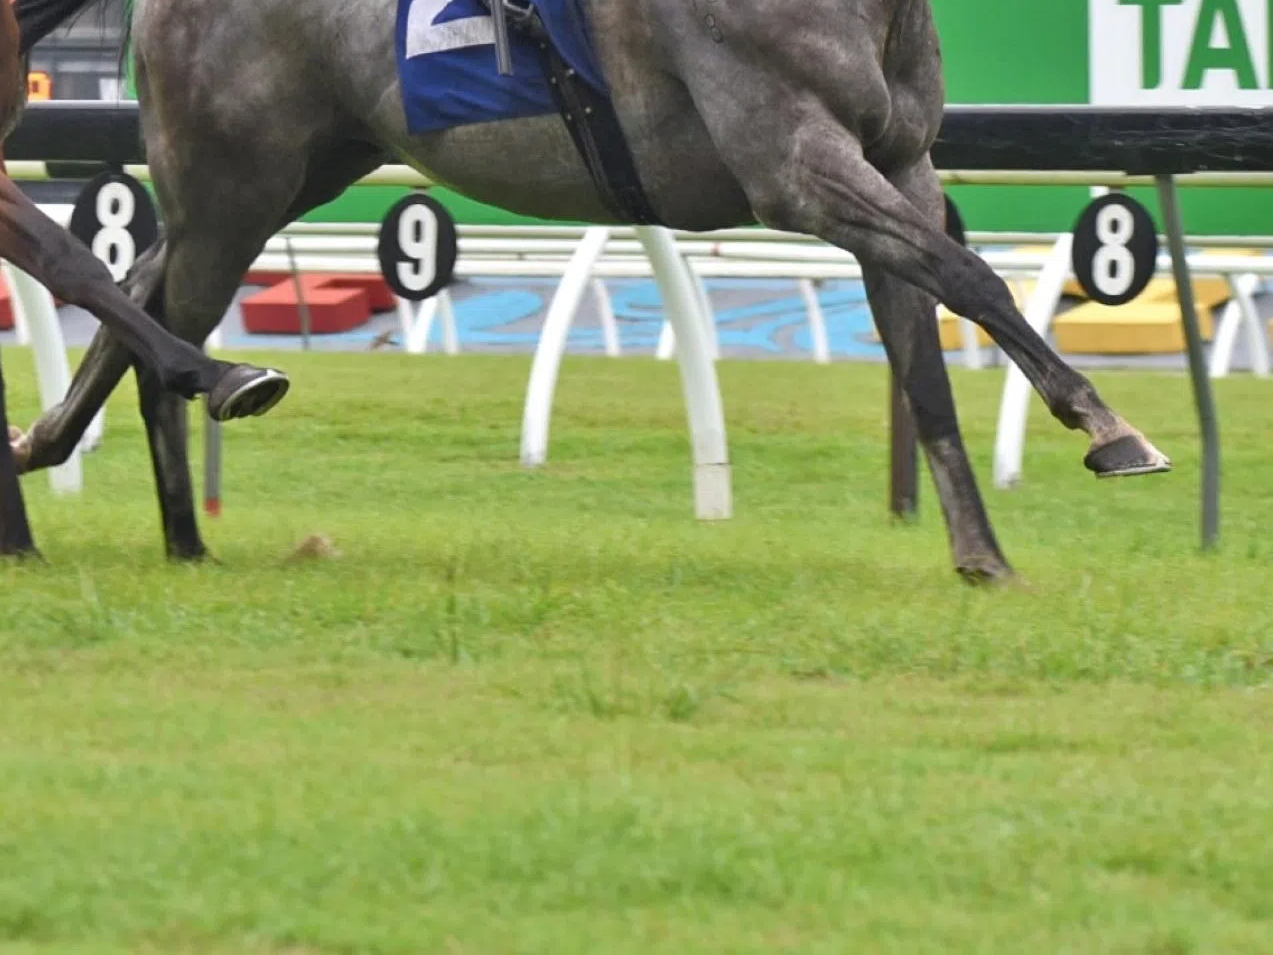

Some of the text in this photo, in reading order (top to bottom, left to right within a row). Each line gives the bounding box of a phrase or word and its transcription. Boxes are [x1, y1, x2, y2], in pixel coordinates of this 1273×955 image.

[91, 182, 136, 282] 8
[397, 203, 438, 291] 9
[1092, 203, 1135, 296] 8
